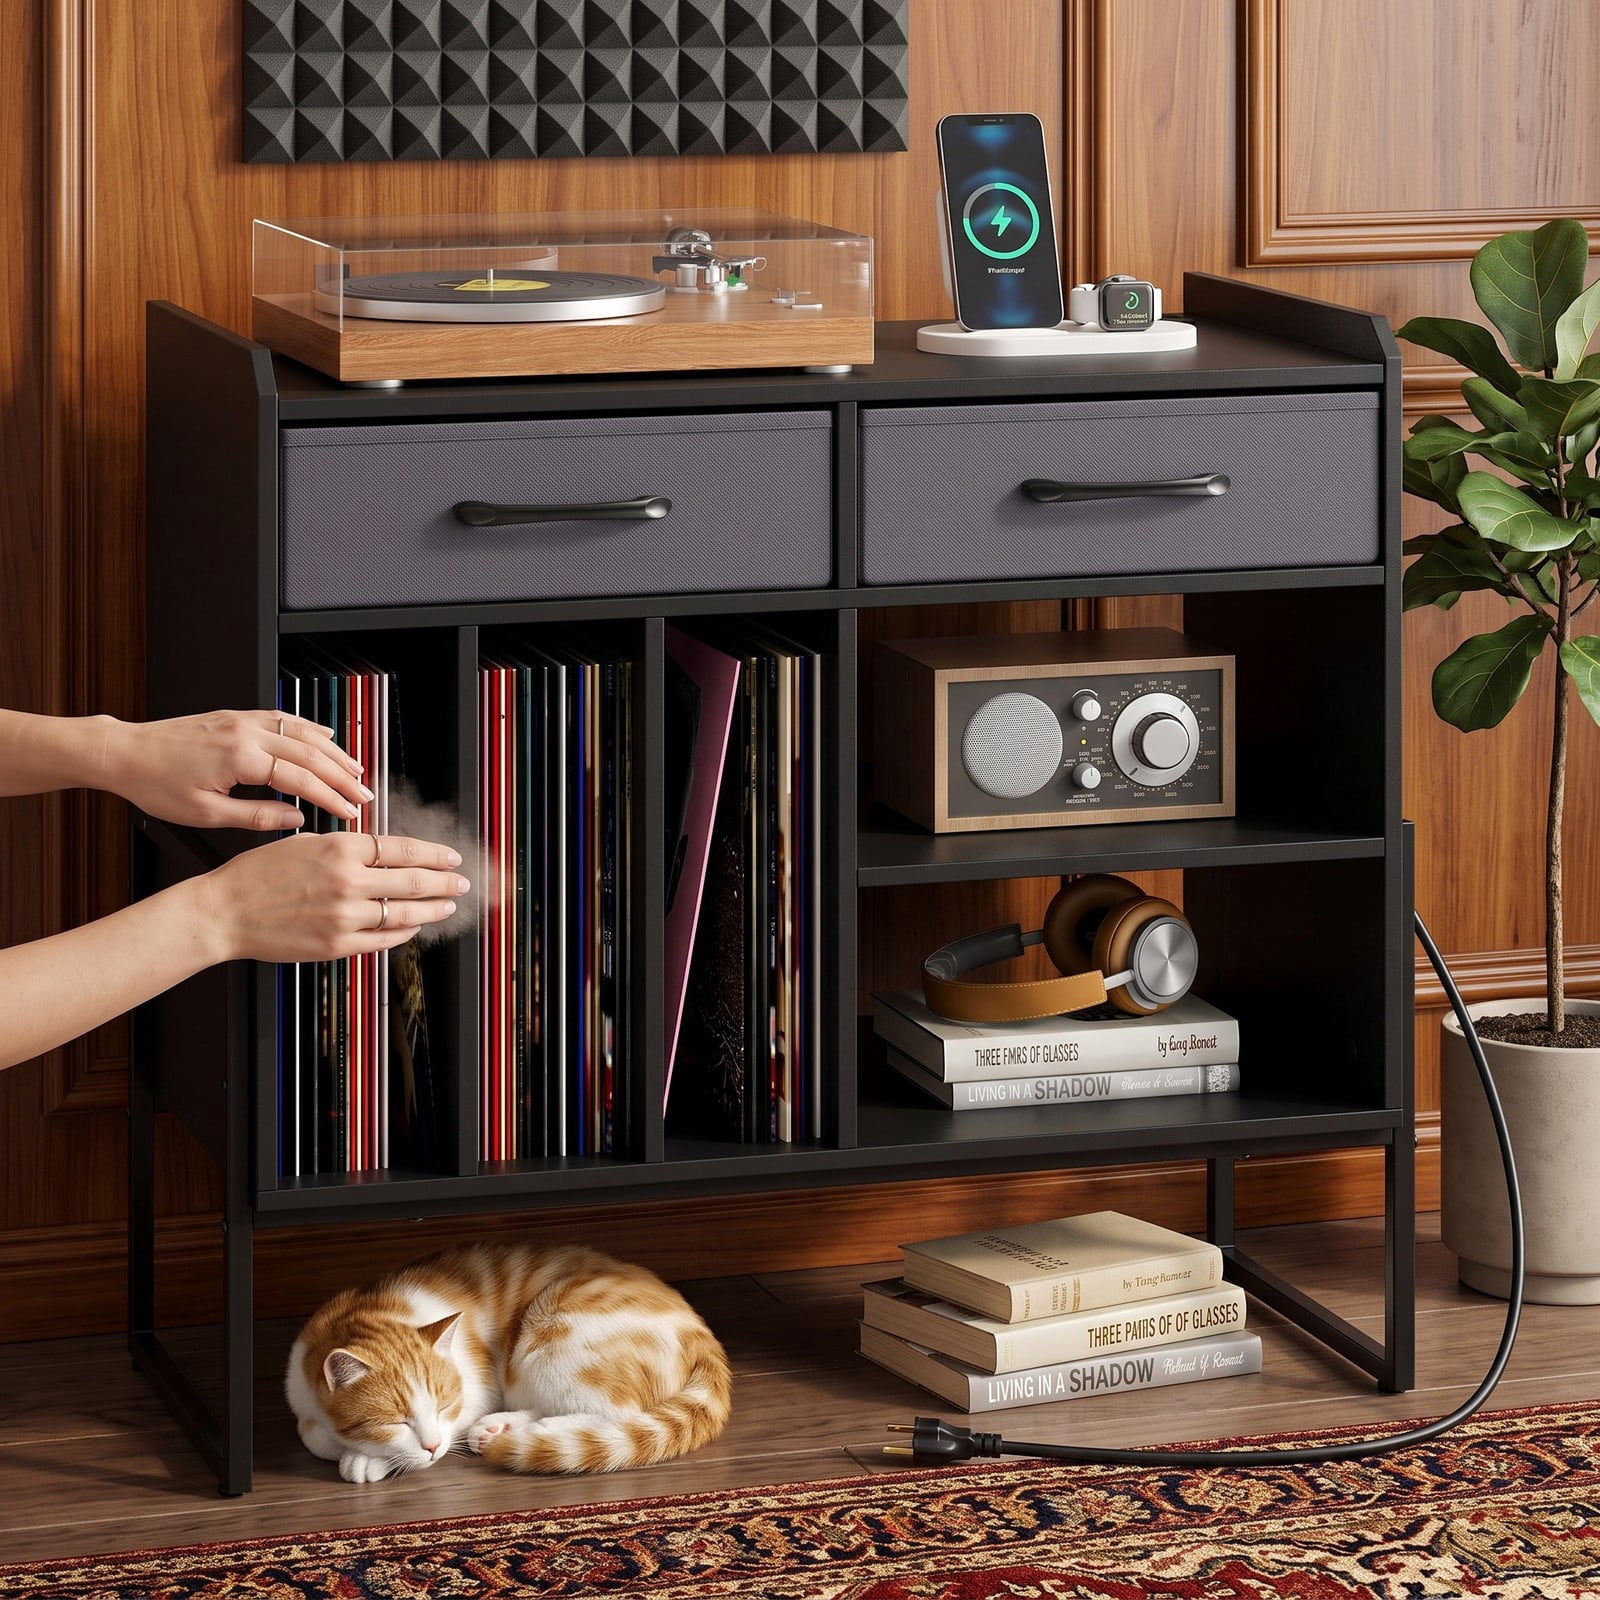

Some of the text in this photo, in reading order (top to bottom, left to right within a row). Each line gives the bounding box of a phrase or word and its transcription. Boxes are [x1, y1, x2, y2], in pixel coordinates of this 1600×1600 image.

[975, 1049, 1001, 1067] THREE
[1030, 1045, 1040, 1064] OF
[1043, 1043, 1079, 1062] GLASSES
[1157, 1036, 1167, 1057] by
[968, 1085, 1006, 1102] LIVING
[1009, 1084, 1020, 1100] IN
[1023, 1083, 1032, 1099] A
[1034, 1076, 1112, 1100] SHADOW
[1122, 1279, 1132, 1292] by
[1087, 1324, 1122, 1349] THREE
[1158, 1314, 1172, 1335] OF
[1175, 1311, 1189, 1332] OF
[1192, 1302, 1239, 1329] GLASSES
[988, 1357, 1155, 1403] LIVING IN A SHADOW
